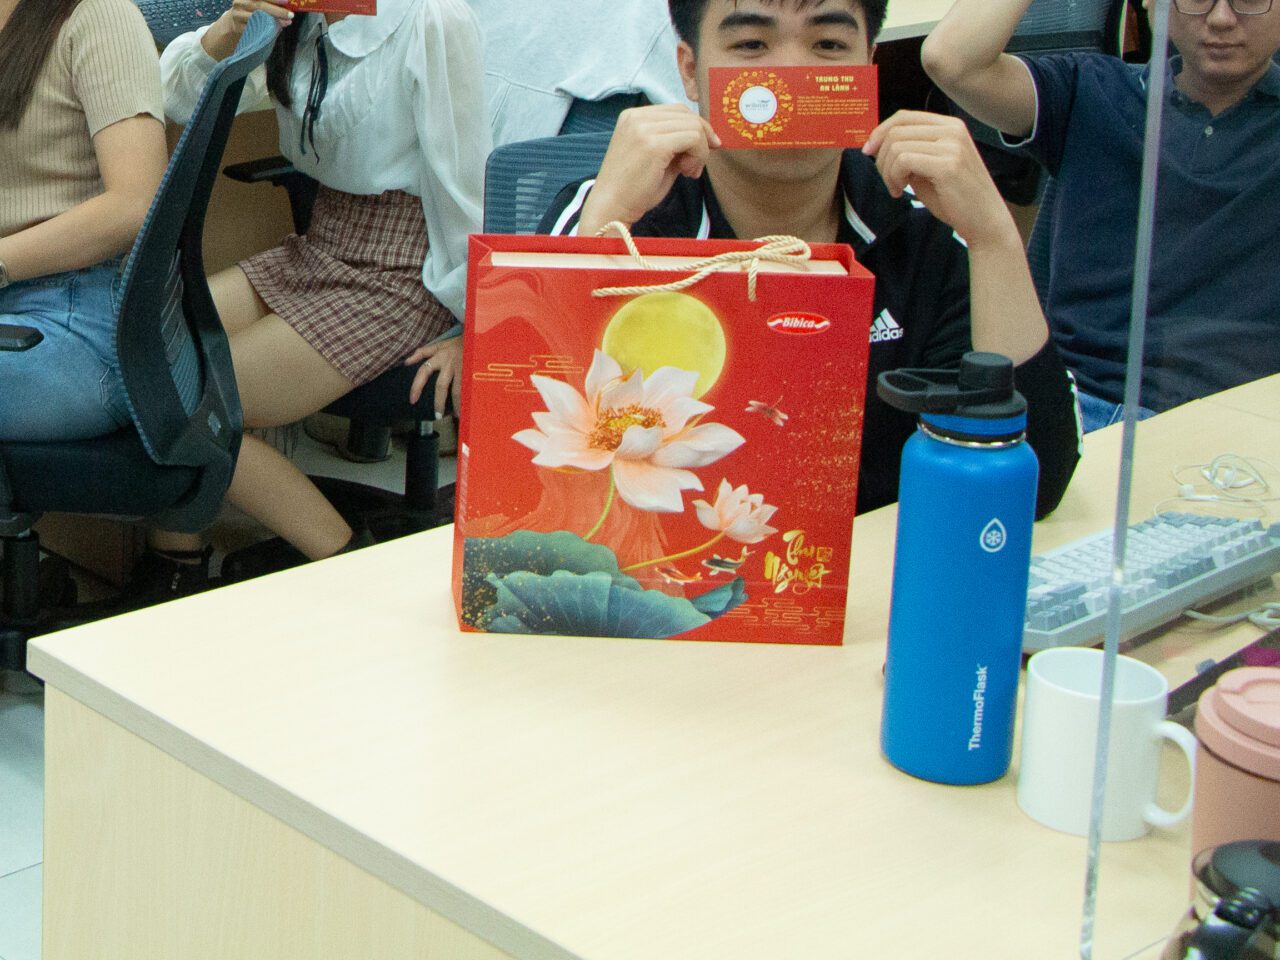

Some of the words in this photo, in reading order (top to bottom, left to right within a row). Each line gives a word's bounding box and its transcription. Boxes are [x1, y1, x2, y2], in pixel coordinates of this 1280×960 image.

[815, 75, 839, 84] TRUNG
[840, 75, 855, 83] THU
[819, 84, 831, 92] AN
[782, 317, 816, 329] Bibica
[967, 664, 988, 751] ThermoFlask
